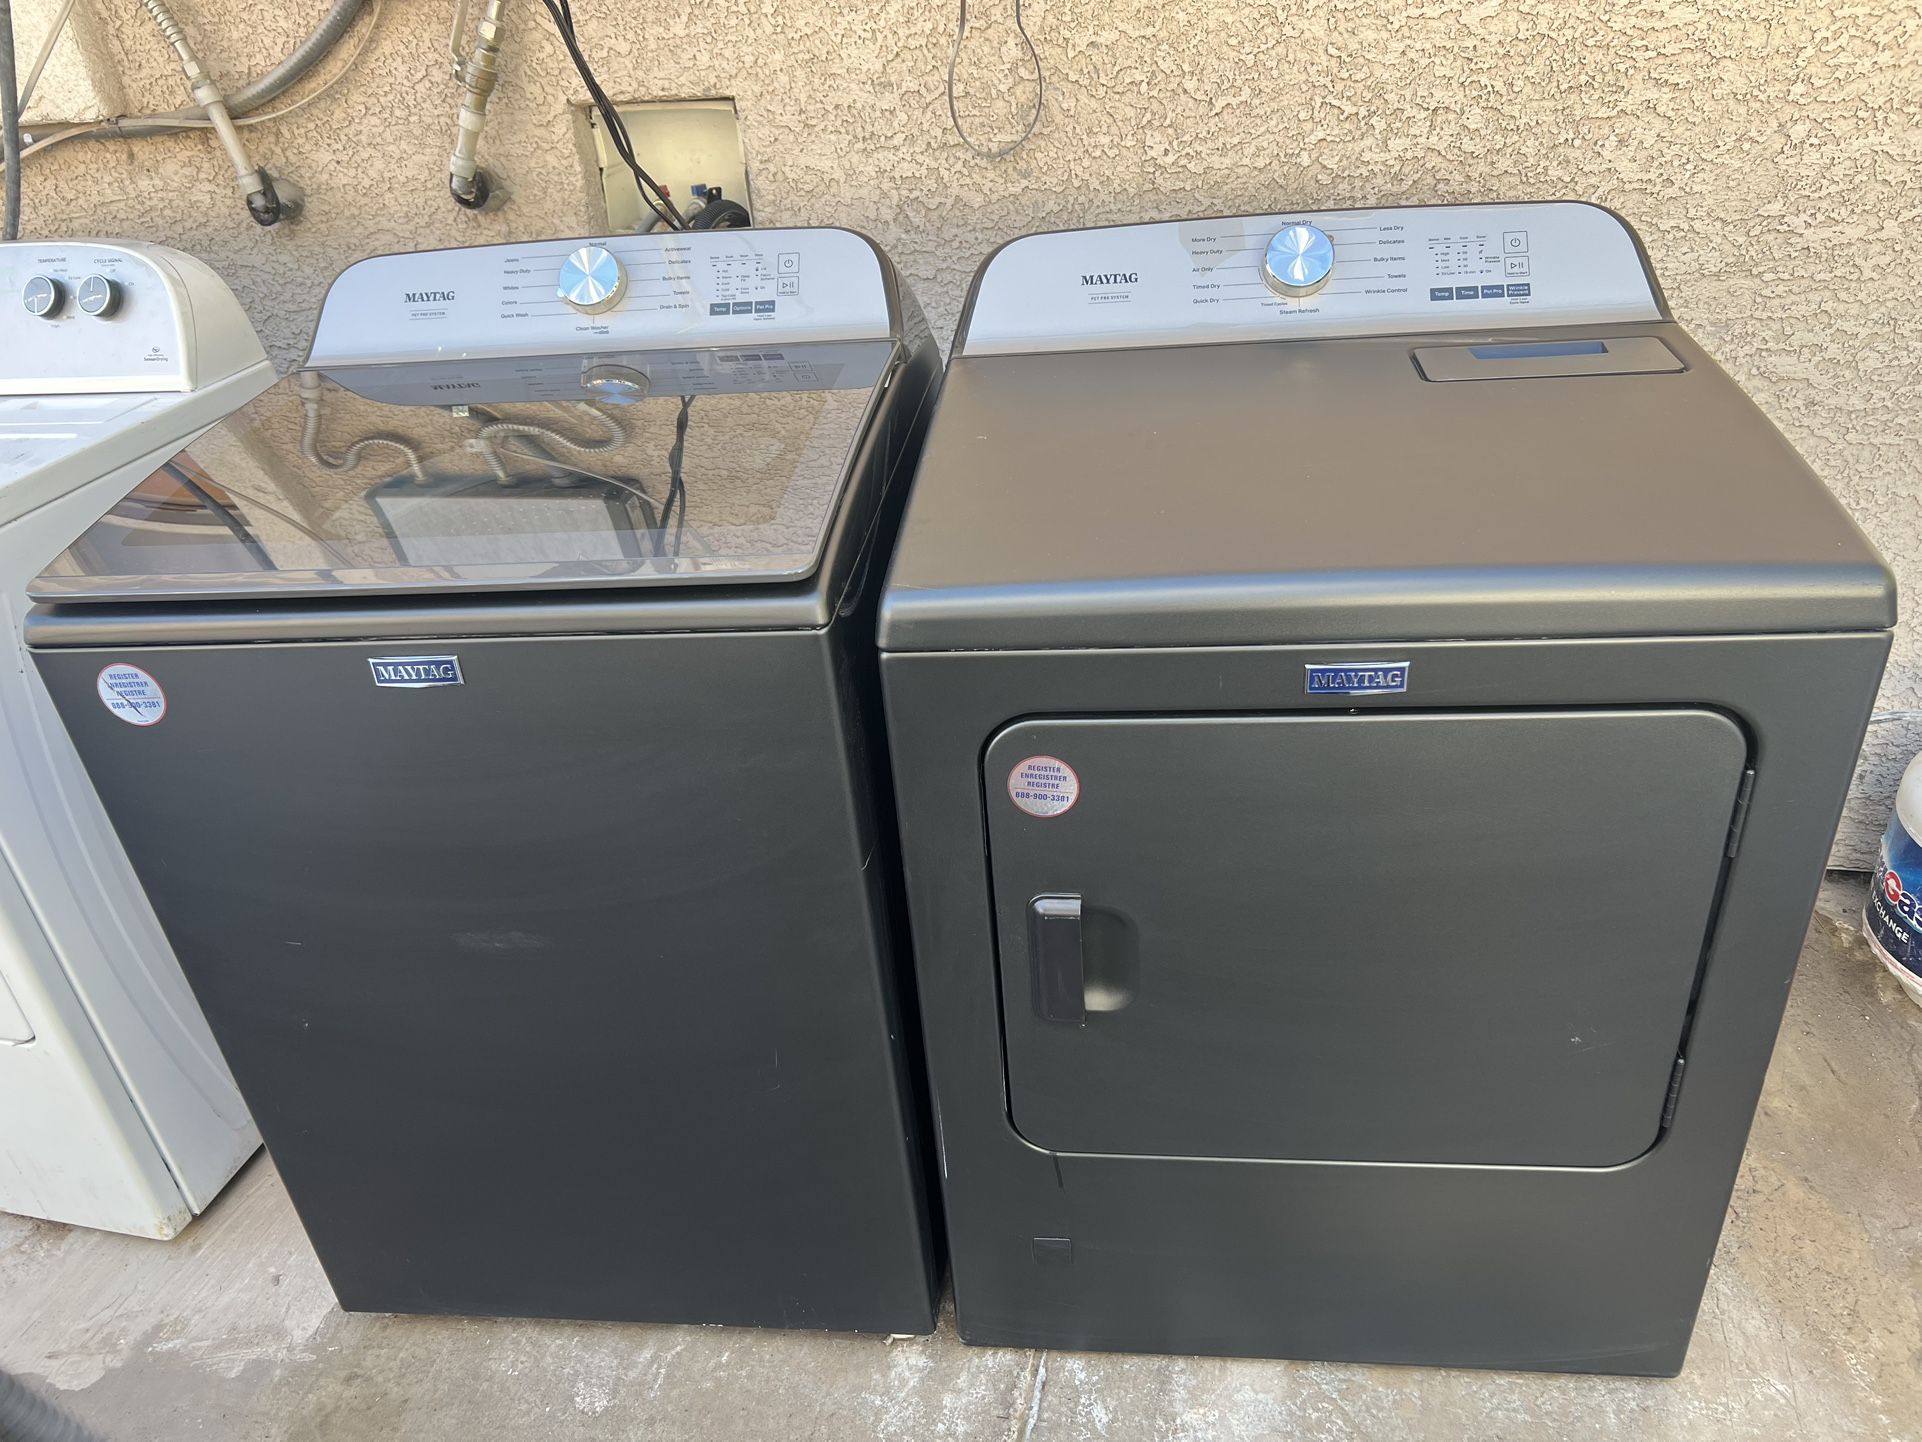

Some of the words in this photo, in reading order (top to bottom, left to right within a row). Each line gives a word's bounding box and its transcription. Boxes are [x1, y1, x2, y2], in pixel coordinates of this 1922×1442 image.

[1081, 272, 1138, 286] MAYTAG
[404, 290, 455, 303] MAYTAG
[108, 672, 140, 681] REGISTER
[376, 664, 455, 680] MAYTAG
[107, 681, 149, 689] NREGISTRER
[1311, 671, 1402, 688] MAYTAG
[115, 689, 146, 697] REGISTRE
[1027, 764, 1061, 774] REGISTER
[1020, 772, 1067, 782] ENREGISTRER
[1026, 781, 1060, 790] REGISTRE
[1015, 791, 1070, 803] 888-900-3381
[1871, 890, 1910, 943] EXCHANGE
